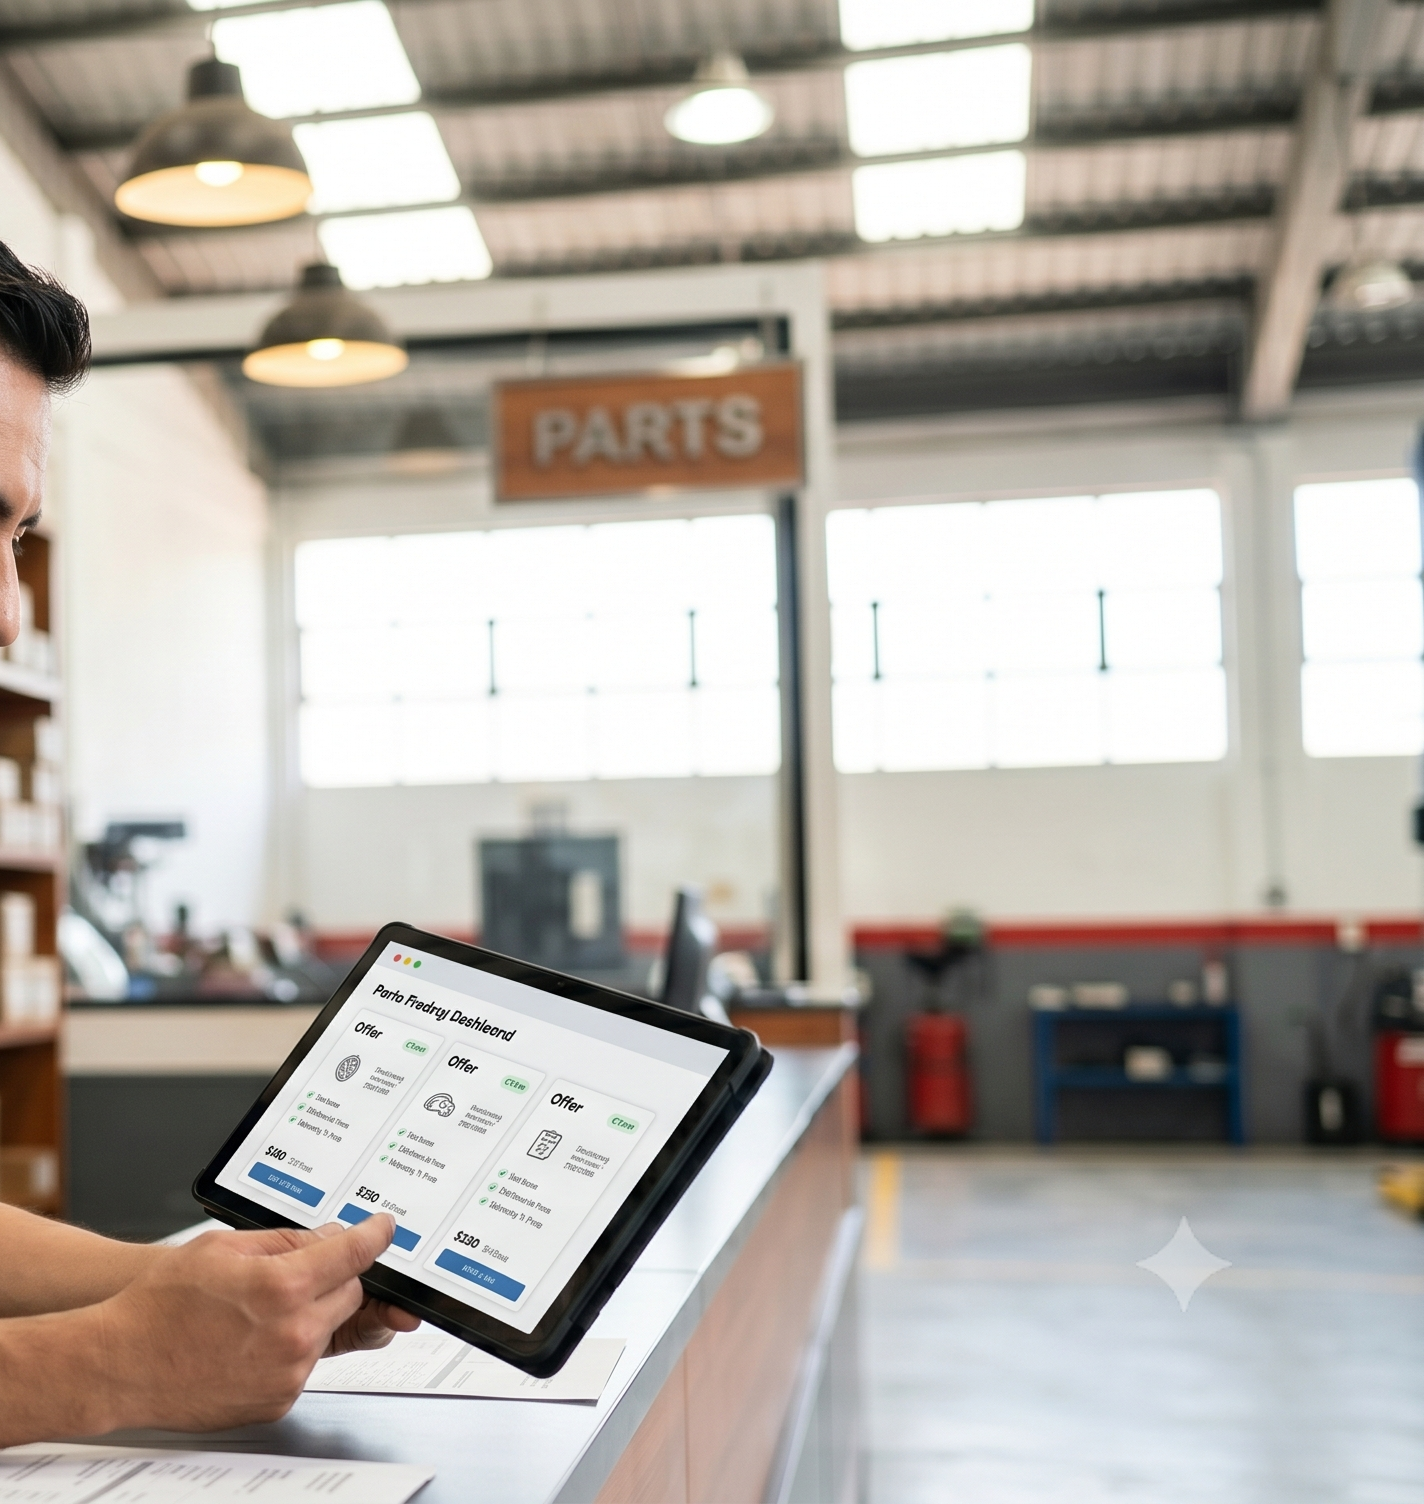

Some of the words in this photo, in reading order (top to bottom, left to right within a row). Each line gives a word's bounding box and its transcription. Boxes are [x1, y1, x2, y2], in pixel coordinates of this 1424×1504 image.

[532, 395, 765, 467] PARTS
[354, 1022, 383, 1039] Offer
[448, 1055, 478, 1074] Offer
[550, 1093, 584, 1113] Offer
